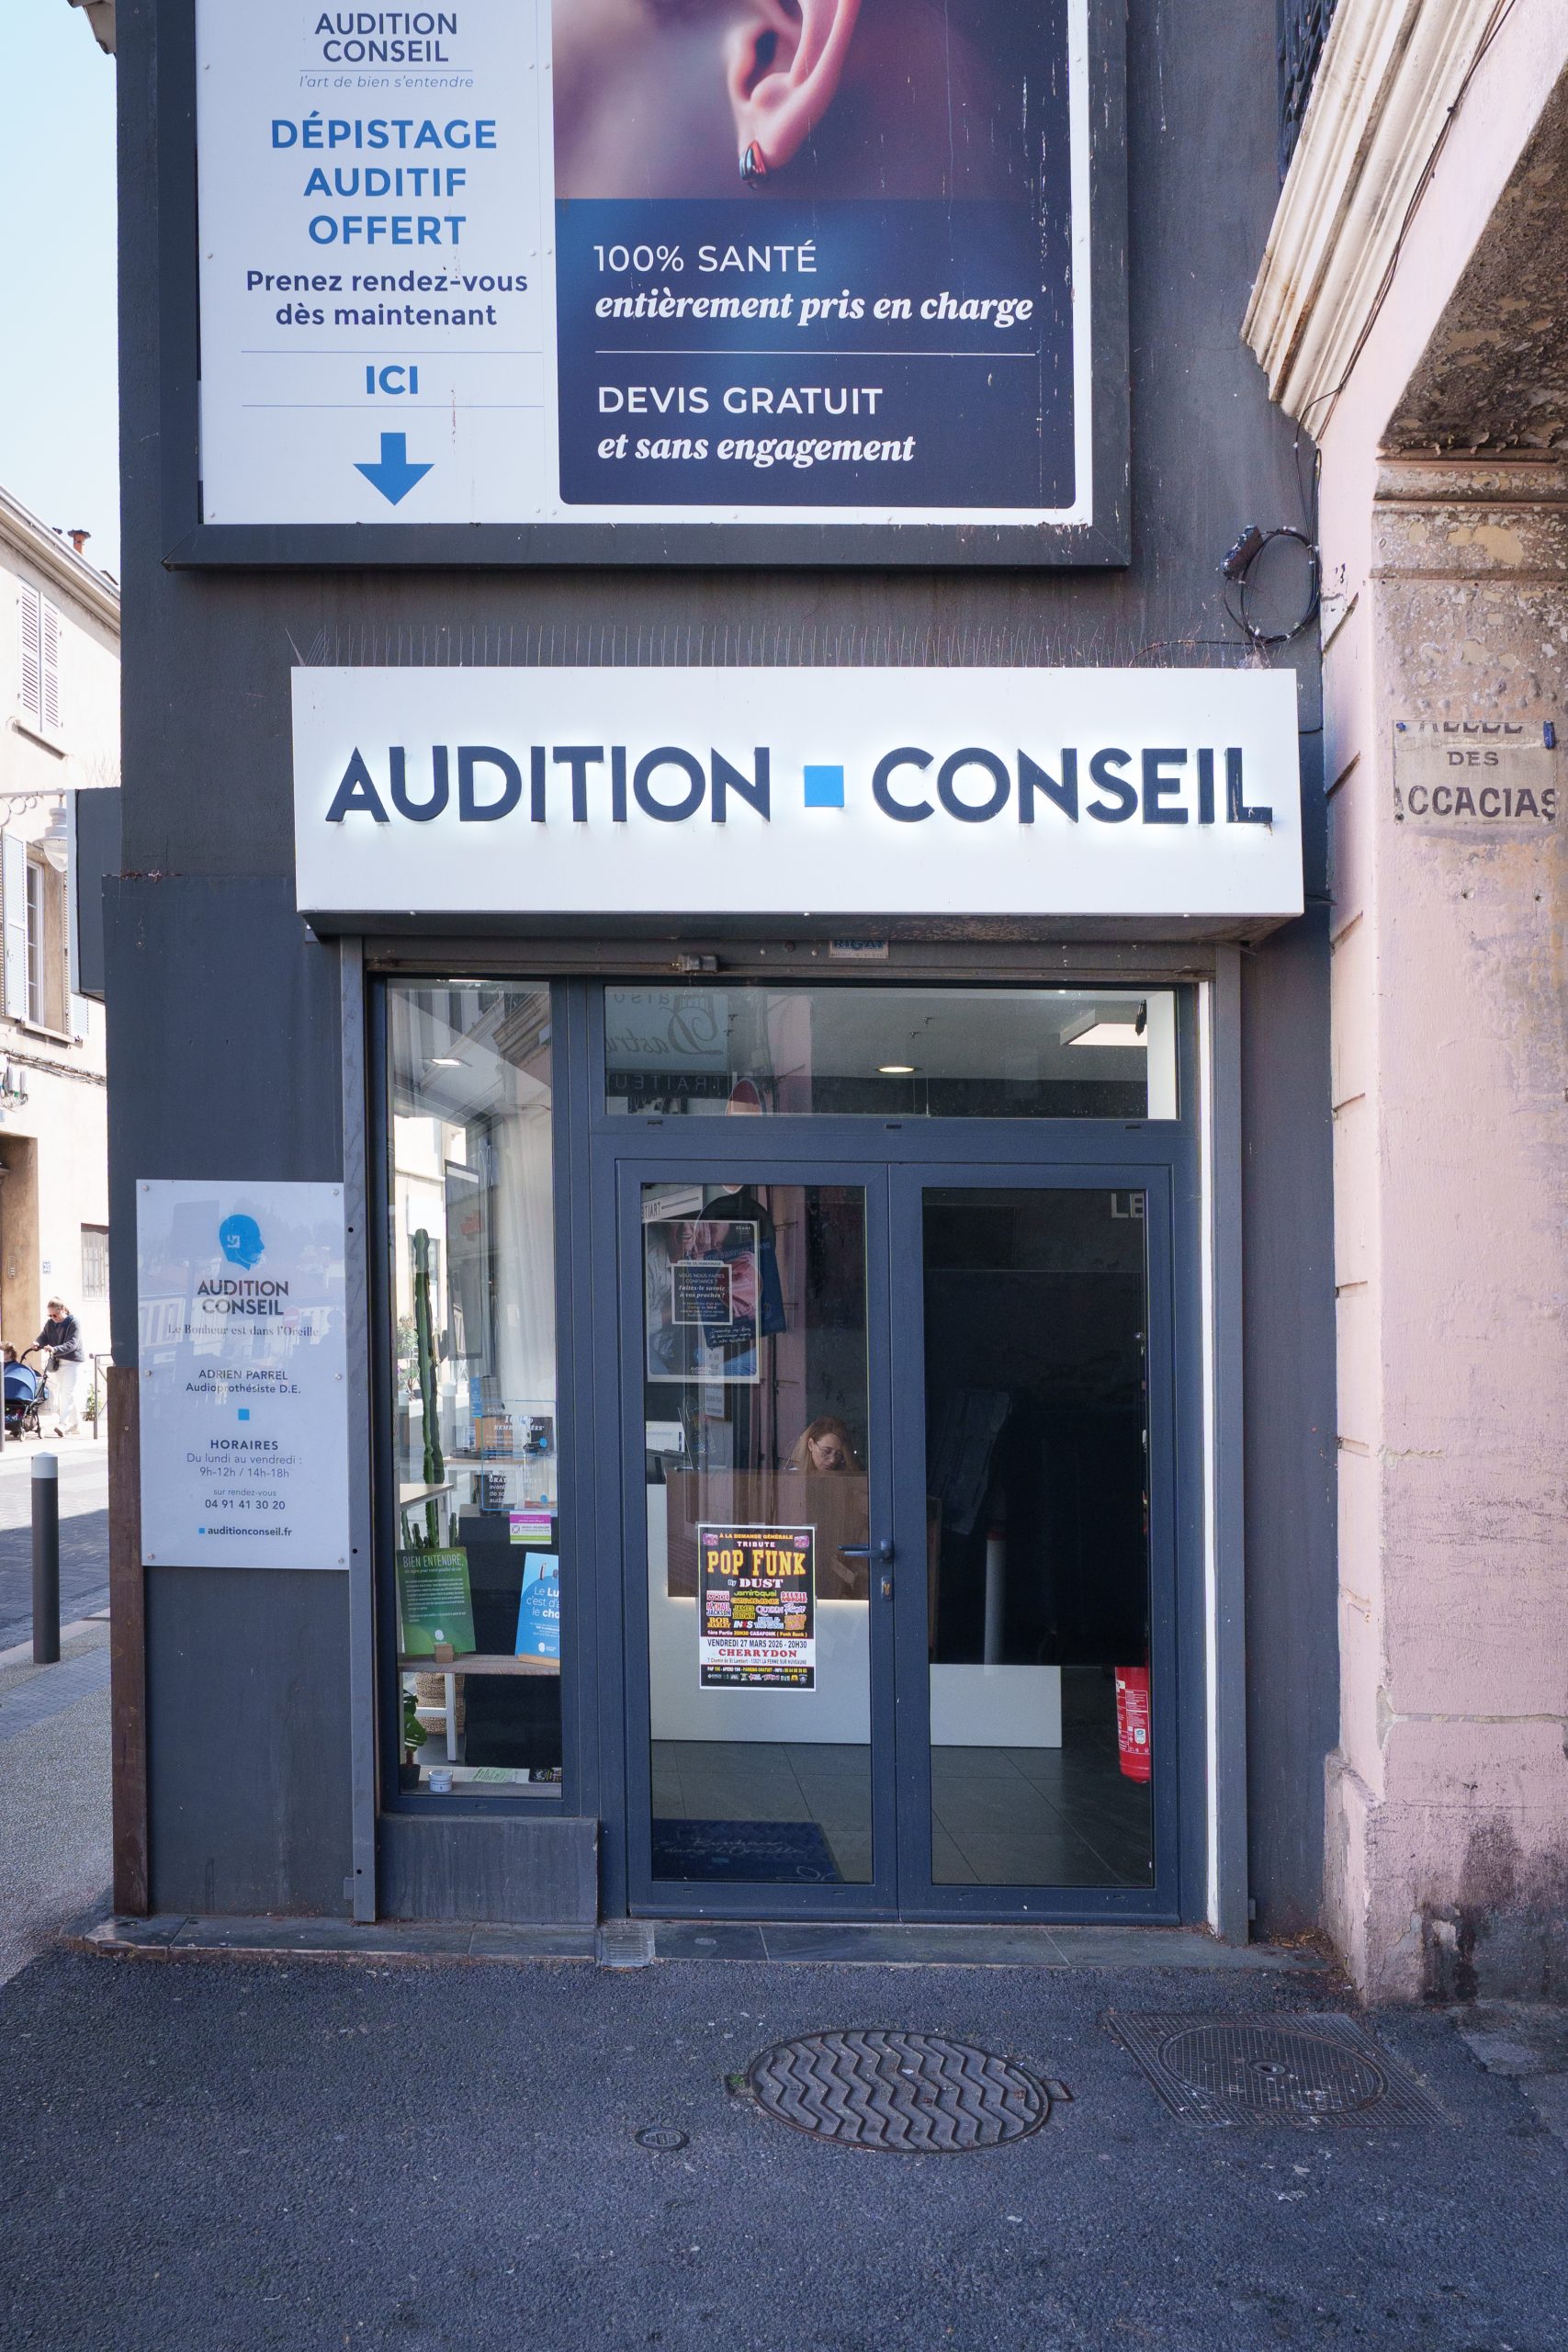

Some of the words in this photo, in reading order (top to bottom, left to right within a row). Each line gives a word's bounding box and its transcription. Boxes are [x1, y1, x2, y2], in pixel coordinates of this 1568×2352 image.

[315, 13, 458, 35] AUDITION
[322, 40, 449, 63] CONSEIL
[299, 75, 329, 88] l'art
[333, 75, 353, 88] de
[357, 75, 389, 88] bien
[394, 75, 474, 88] s'entendre
[271, 110, 498, 150] DÉPISTAGE
[303, 167, 467, 198] AUDITIF
[308, 215, 467, 245] OFFERT
[593, 244, 684, 273] 100%
[697, 240, 818, 273] SANTÉ
[246, 270, 343, 292] Prenez
[352, 270, 528, 293] rendez-vous
[276, 303, 325, 326] dès
[333, 305, 497, 326] maintenant
[594, 288, 794, 320] entièrement
[797, 289, 865, 327] pris
[873, 296, 912, 320] en
[919, 292, 1033, 328] charge
[366, 366, 419, 395] ICI
[598, 387, 709, 414] DEVIS
[723, 387, 884, 415] GRATUIT
[597, 435, 627, 459] et
[635, 438, 709, 461] sans
[716, 435, 916, 469] engagement
[1446, 751, 1499, 765] DES
[325, 745, 771, 823] AUDITION
[872, 747, 1274, 824] CONSEIL
[197, 1280, 289, 1296] AUDITION
[202, 1299, 285, 1316] CONSEIL
[168, 1325, 182, 1334] Le
[184, 1325, 229, 1335] Bonheur
[231, 1327, 247, 1335] est
[250, 1326, 274, 1336] dans
[198, 1370, 243, 1379] ADRIEN
[246, 1371, 288, 1380] PARREL
[186, 1383, 276, 1394] Audioprothésiste
[279, 1385, 301, 1394] D.E.
[210, 1440, 279, 1451] HORAIRES
[186, 1453, 202, 1463] Du
[205, 1453, 231, 1464] lundi
[234, 1455, 246, 1464] au
[250, 1454, 296, 1464] vendredi
[199, 1466, 236, 1477] 9h-12h
[248, 1467, 289, 1477] 14h-18h
[228, 1488, 276, 1497] rendez-vous
[205, 1499, 219, 1509] 04
[221, 1499, 234, 1509] 91
[238, 1500, 250, 1509] 41
[255, 1500, 269, 1510] 30
[272, 1501, 286, 1510] 20
[208, 1526, 292, 1536] auditionconseil.fr
[402, 1555, 421, 1568] BIEN
[706, 1549, 744, 1576] POP
[751, 1549, 807, 1577] FUNK
[739, 1577, 784, 1589] DUST
[534, 1586, 545, 1596] Le
[526, 1596, 546, 1606] c'est
[532, 1608, 540, 1616] le
[707, 1639, 739, 1647] VENDREDI
[740, 1639, 747, 1647] 27
[768, 1640, 783, 1648] 2026
[788, 1640, 807, 1649] 20H30
[718, 1648, 797, 1657] CHERRYDON
